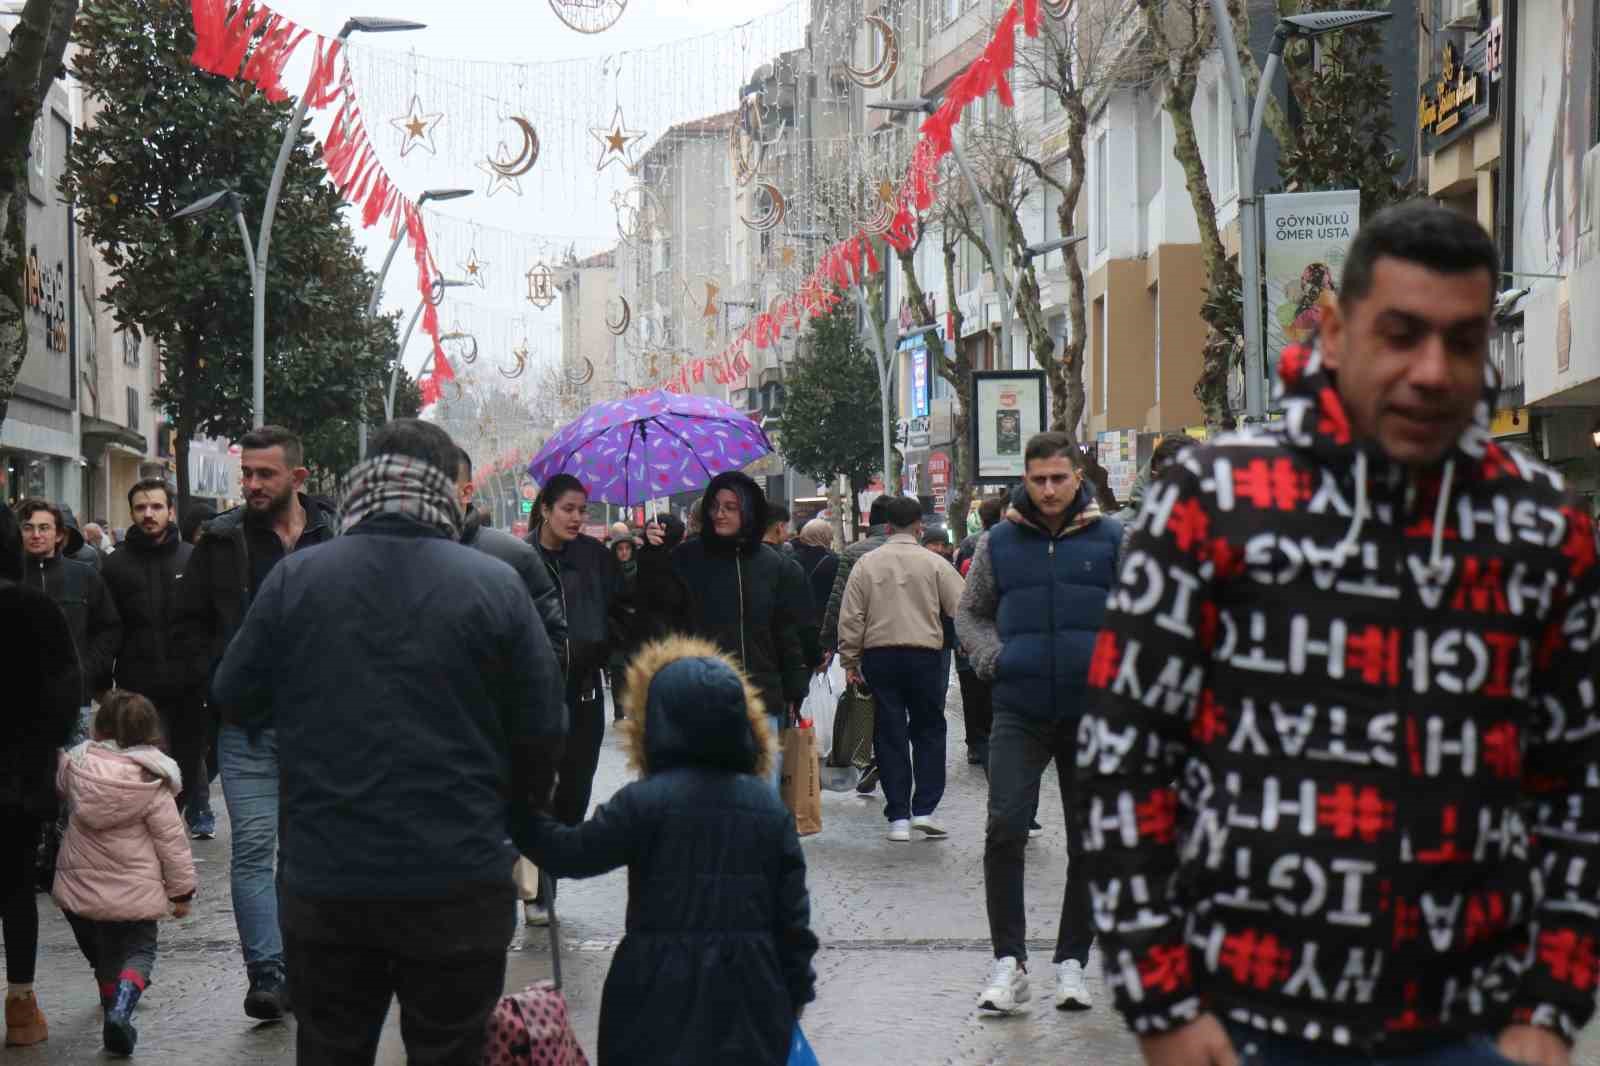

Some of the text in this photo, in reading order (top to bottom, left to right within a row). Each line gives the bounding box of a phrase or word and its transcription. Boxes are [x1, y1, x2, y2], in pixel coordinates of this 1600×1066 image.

[1275, 211, 1350, 228] GÖYNÜKLÜ
[1275, 226, 1350, 241] ÖMER USTA
